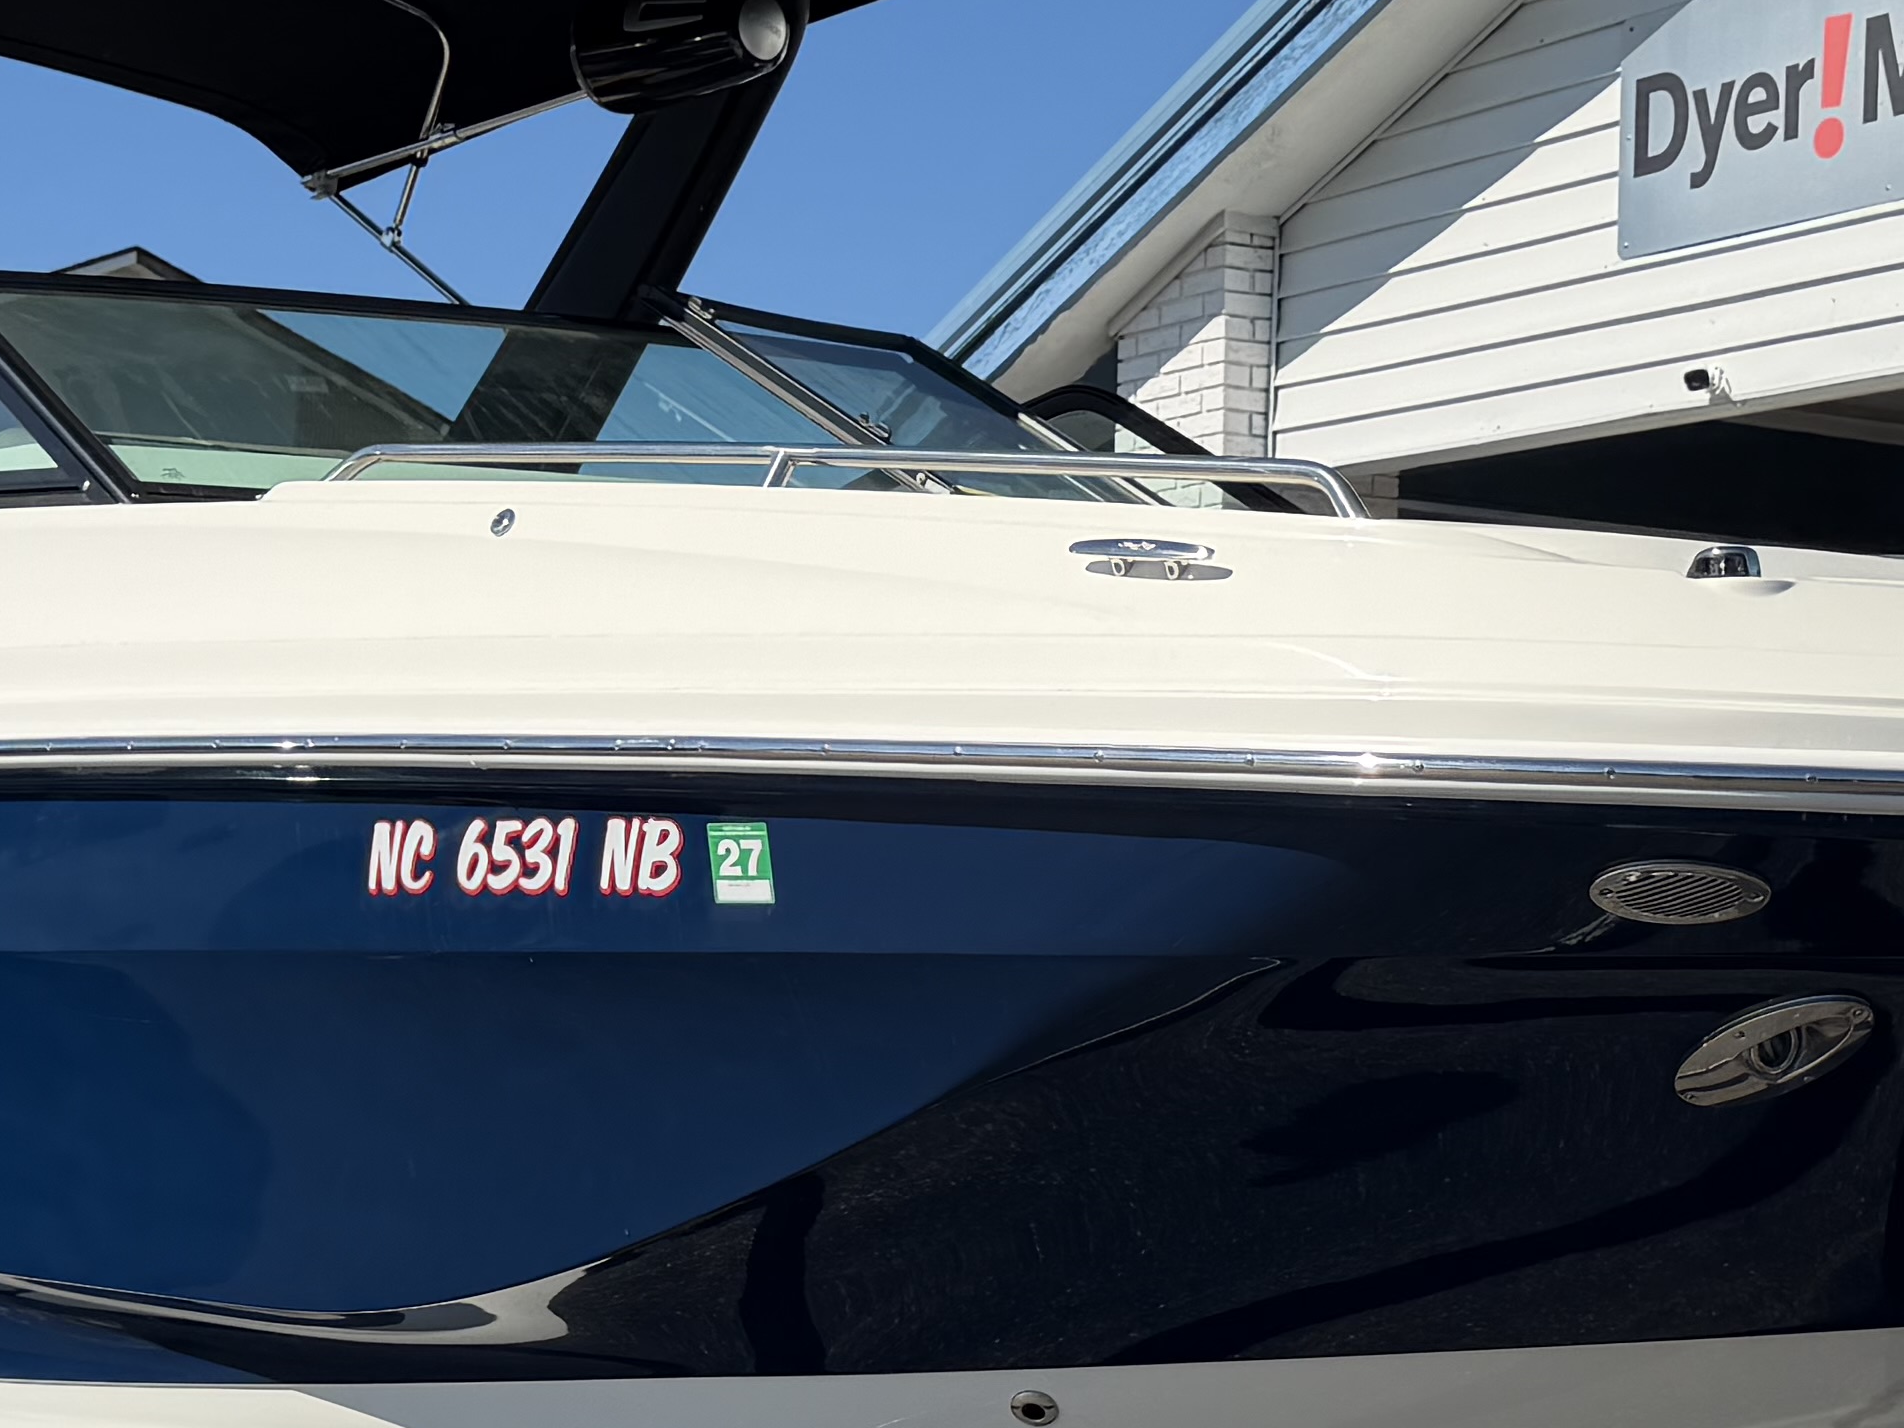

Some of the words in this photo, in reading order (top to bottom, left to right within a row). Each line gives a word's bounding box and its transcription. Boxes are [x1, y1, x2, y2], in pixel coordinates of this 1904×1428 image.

[367, 817, 437, 897] NC
[456, 816, 579, 897] 6531
[599, 816, 685, 897] NB
[717, 838, 763, 877] 27
